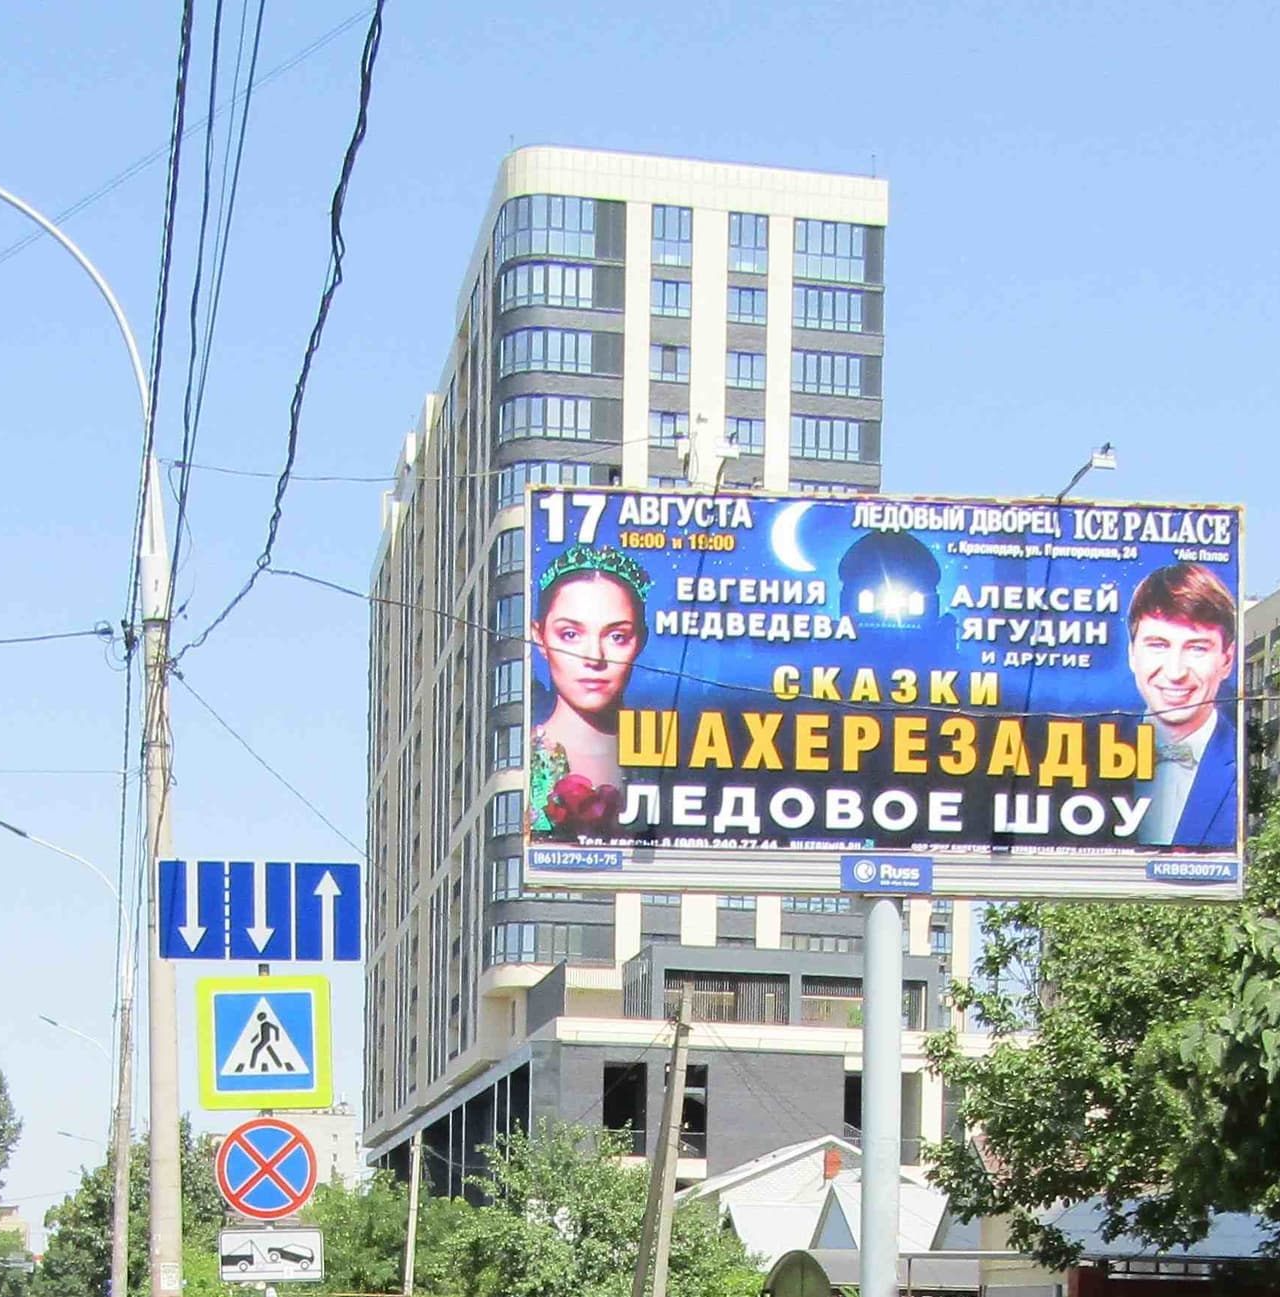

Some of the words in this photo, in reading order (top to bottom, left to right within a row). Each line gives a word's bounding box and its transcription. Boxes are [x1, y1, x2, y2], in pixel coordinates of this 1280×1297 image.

[540, 494, 606, 544] 17
[619, 496, 753, 529] АВГУСТА
[851, 503, 965, 534] ЛЕДОВЫЙ
[969, 505, 1061, 536] ДВОРЕЦ
[1073, 508, 1119, 541] ICE
[1123, 511, 1231, 545] PALACE
[620, 531, 665, 549] 16:00
[672, 537, 682, 548] и
[688, 533, 735, 551] 19:00
[1123, 547, 1137, 559] 24
[676, 577, 826, 605] ЕВГЕНИЯ
[951, 583, 1119, 613] АЛЕКСЕЙ
[655, 611, 857, 642] МЕДВЕДЕВА
[962, 618, 1108, 646] ЯГУДИН
[981, 652, 995, 665] И
[1003, 653, 1091, 668] ДРУГИЕ
[773, 664, 999, 706] СКАЗКИ
[618, 709, 1155, 788] ШАХЕРЕЗАДЫ
[619, 784, 964, 834] ЛЕДОВОЕ
[994, 793, 1152, 837] ШОУ
[880, 863, 920, 880] Russ
[1153, 863, 1231, 877] KRBB30077A
